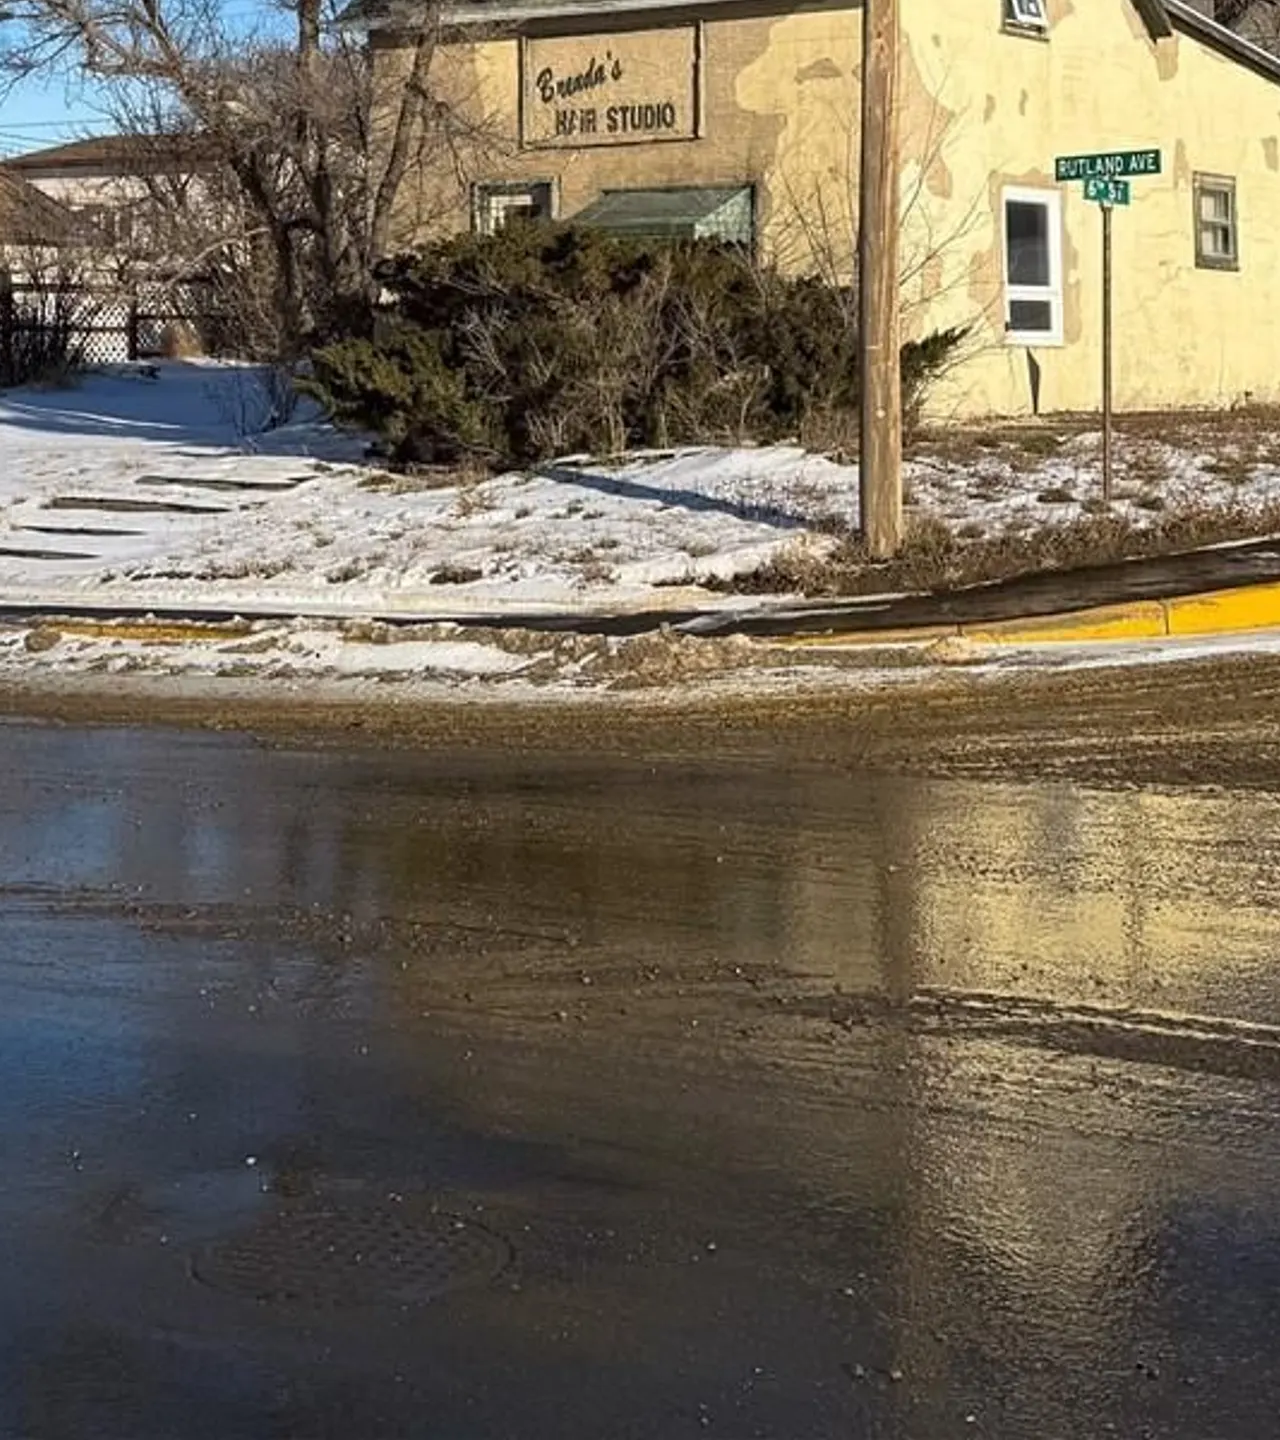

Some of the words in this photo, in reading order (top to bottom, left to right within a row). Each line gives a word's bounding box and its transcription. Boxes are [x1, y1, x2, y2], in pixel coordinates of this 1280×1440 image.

[536, 49, 622, 103] Brenda's
[606, 102, 675, 133] STUDIO
[1058, 155, 1124, 177] RUTLAND
[1129, 153, 1157, 171] AVE
